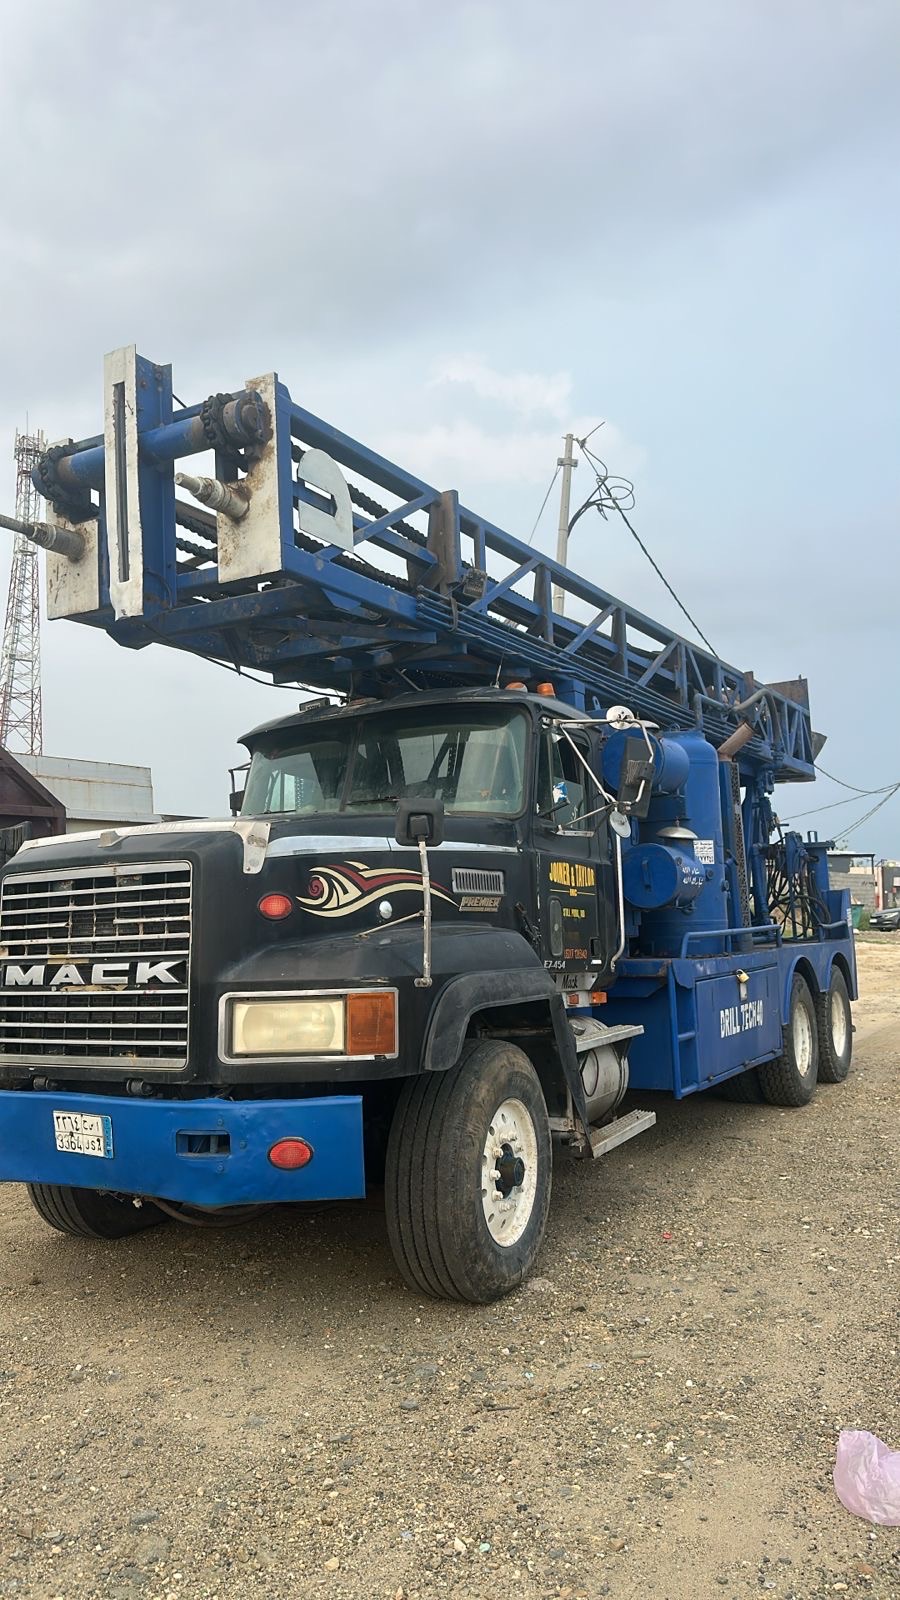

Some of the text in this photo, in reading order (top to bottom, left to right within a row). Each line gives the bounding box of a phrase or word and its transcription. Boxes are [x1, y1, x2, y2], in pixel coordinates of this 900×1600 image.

[575, 864, 595, 887] TAYLOR
[460, 896, 502, 908] PREMIER
[5, 961, 184, 986] MACK
[562, 974, 578, 989] Mack
[719, 1006, 741, 1039] DRILL
[57, 1133, 83, 1151] 3364
